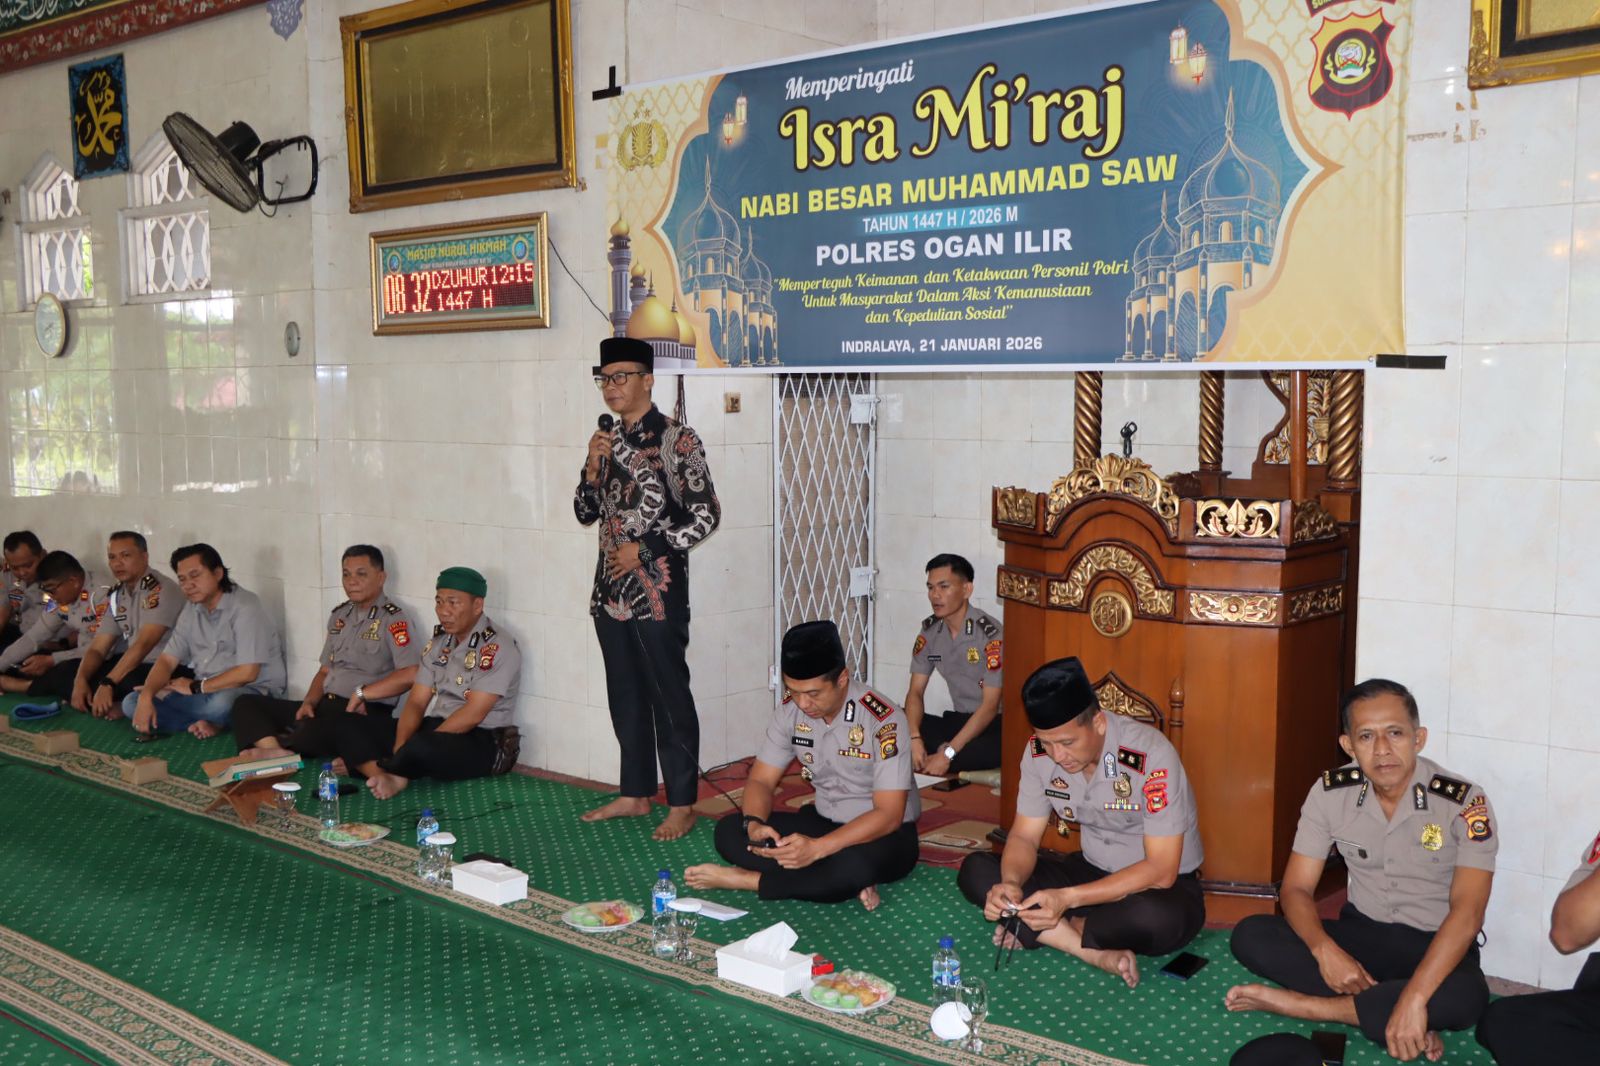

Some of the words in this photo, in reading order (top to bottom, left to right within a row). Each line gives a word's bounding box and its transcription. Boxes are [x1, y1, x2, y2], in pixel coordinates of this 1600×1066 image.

[785, 59, 915, 101] Memperingati
[779, 106, 900, 172] Isra
[741, 194, 799, 218] NABI
[808, 182, 892, 212] BESAR
[902, 163, 1090, 203] MUHAMMAD
[1101, 154, 1178, 187] SAW
[862, 216, 908, 232] TAHUN
[912, 212, 943, 229] 1447
[947, 211, 958, 227] H
[969, 208, 1002, 225] 2026
[1005, 206, 1018, 221] M
[407, 248, 437, 262] MASJID
[438, 244, 467, 257] NURUL
[469, 239, 507, 255] HIKMAH
[816, 240, 916, 266] POLRES
[924, 233, 1003, 259] OGAN
[1014, 228, 1073, 253] ILIR
[432, 267, 488, 289] DZUHUR
[491, 262, 535, 284] 12:15
[855, 273, 919, 287] Keimanan
[923, 270, 950, 284] dan
[954, 266, 1030, 282] Ketakwaan
[1032, 262, 1090, 277] Personil
[1093, 259, 1130, 273] Polri
[438, 291, 473, 311] 1447
[483, 289, 493, 308] H
[802, 293, 837, 307] Untuk
[839, 290, 914, 306] Masyarakat
[916, 289, 961, 303] Dalam
[962, 286, 992, 301] Aksi
[994, 283, 1093, 300] Kemanusiaan
[865, 310, 890, 324] dan
[893, 306, 963, 325] Kepedulian
[841, 340, 915, 353] INDRALAYA,
[919, 340, 937, 352] 21
[940, 338, 1001, 351] JANUARI
[1006, 336, 1043, 350] 2026
